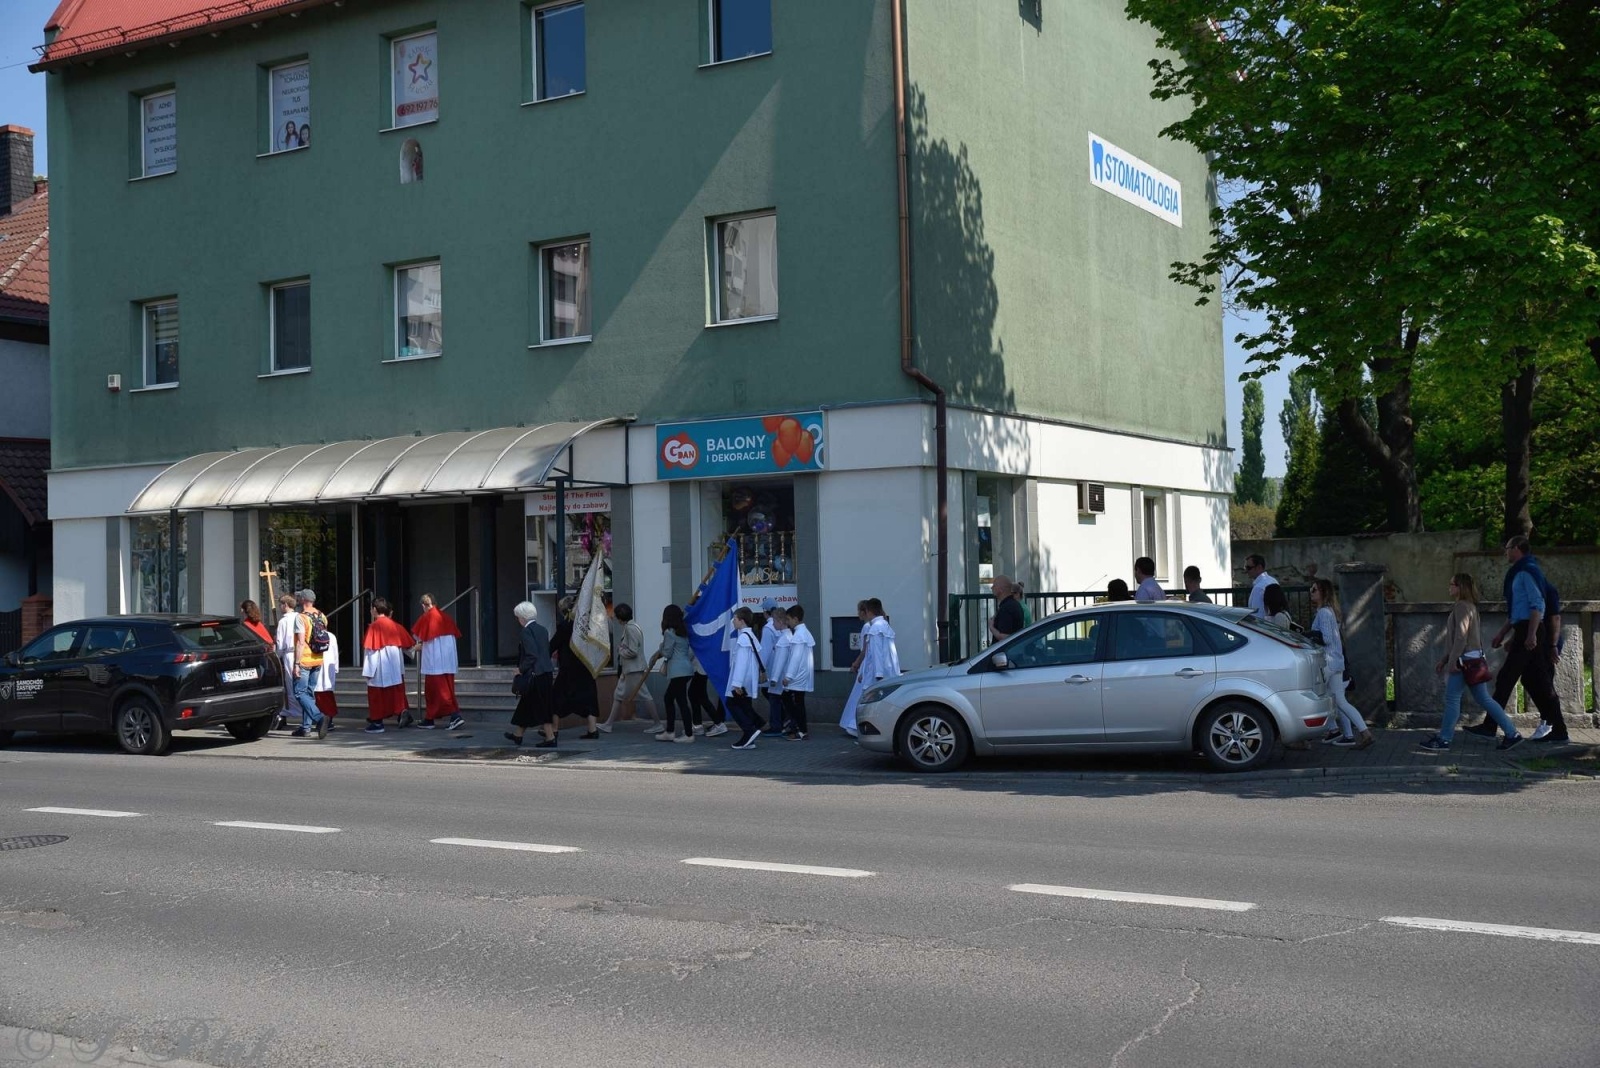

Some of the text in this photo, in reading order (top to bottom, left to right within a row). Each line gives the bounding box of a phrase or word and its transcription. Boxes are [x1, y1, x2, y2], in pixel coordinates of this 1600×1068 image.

[1105, 153, 1179, 216] STOMATOLOGIA
[706, 435, 766, 452] BALONY
[711, 451, 766, 463] DEKORACJE
